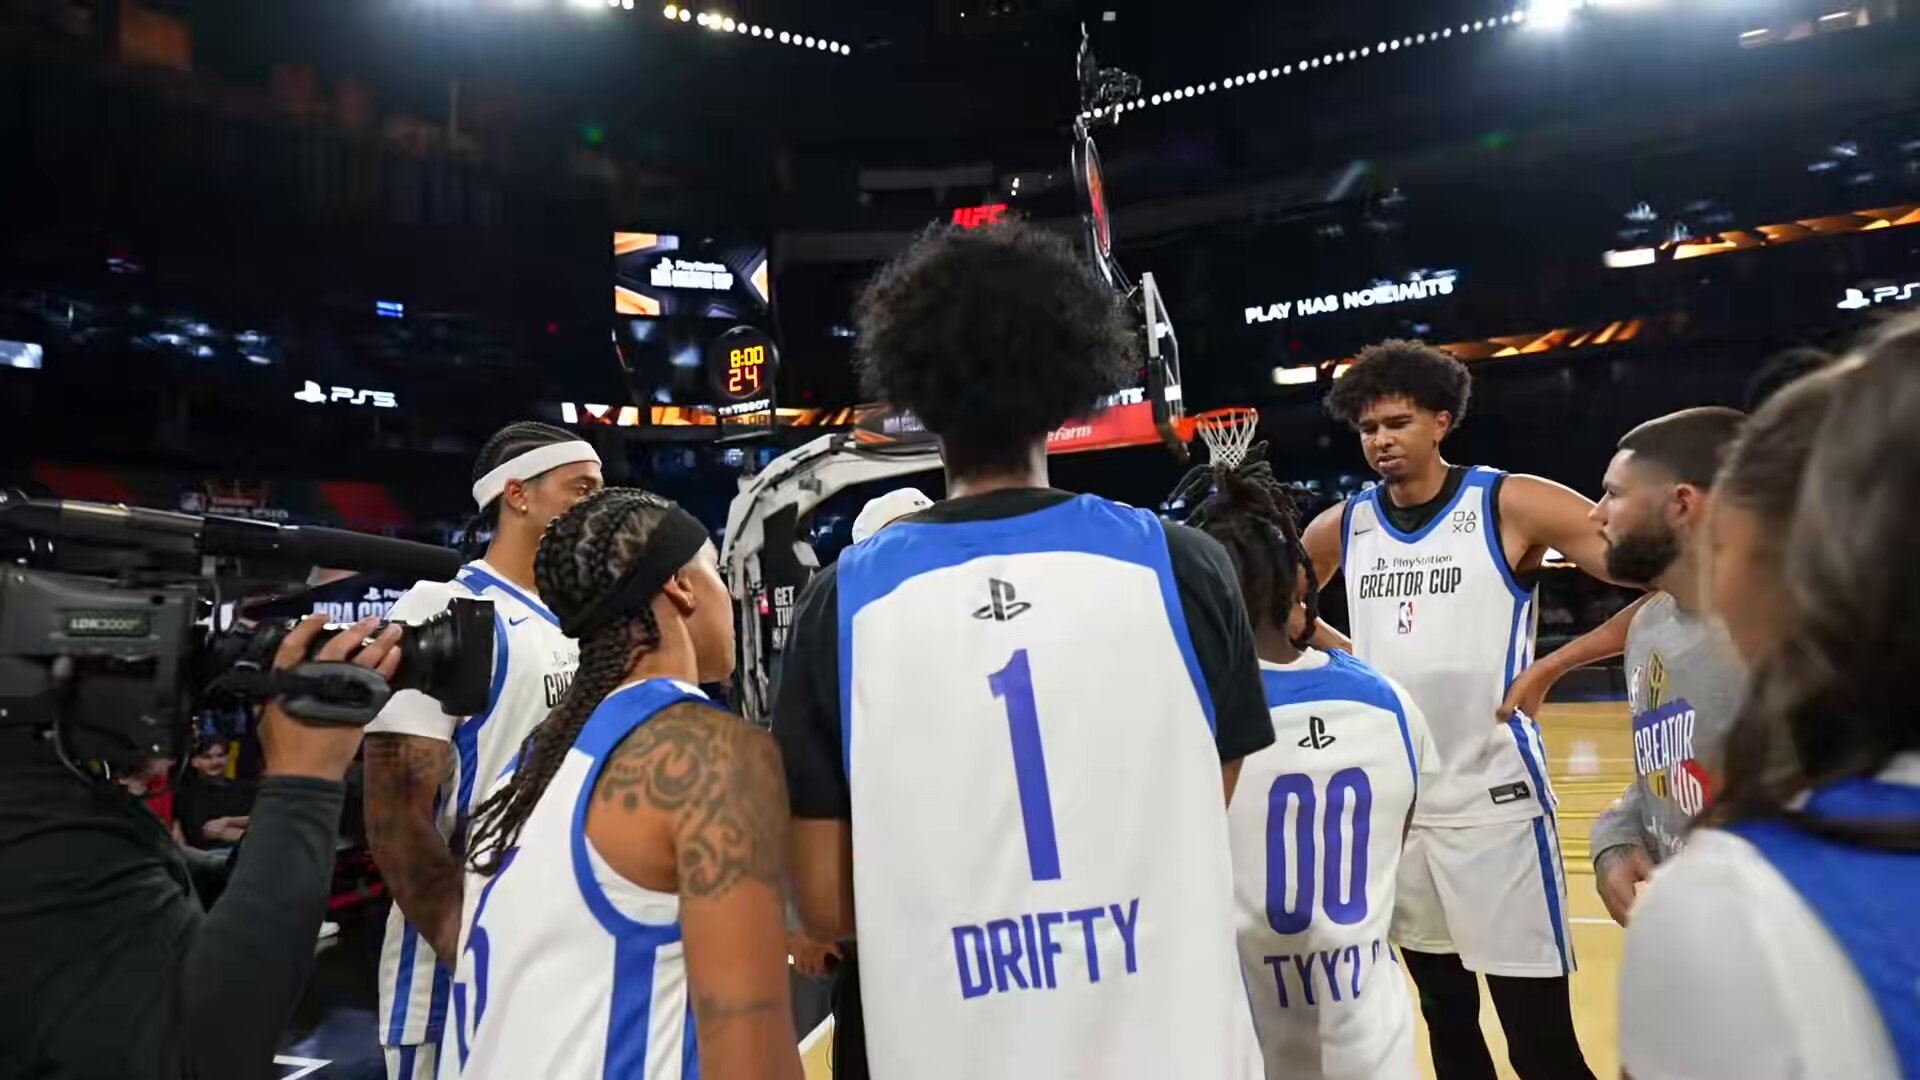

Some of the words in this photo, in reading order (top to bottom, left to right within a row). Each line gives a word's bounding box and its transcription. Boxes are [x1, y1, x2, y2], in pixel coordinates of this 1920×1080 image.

[953, 203, 1008, 229] UFC
[1245, 301, 1292, 325] PLAY
[1297, 294, 1339, 316] HAS
[730, 345, 765, 369] 8:00
[728, 365, 758, 392] 24
[331, 386, 396, 408] PS5
[1360, 570, 1424, 599] CREATOR
[1429, 567, 1462, 594] CUP
[1634, 709, 1697, 776] CREATOR
[987, 648, 1062, 881] 1
[1265, 767, 1373, 935] 00
[951, 897, 1140, 1000] DRIFTY
